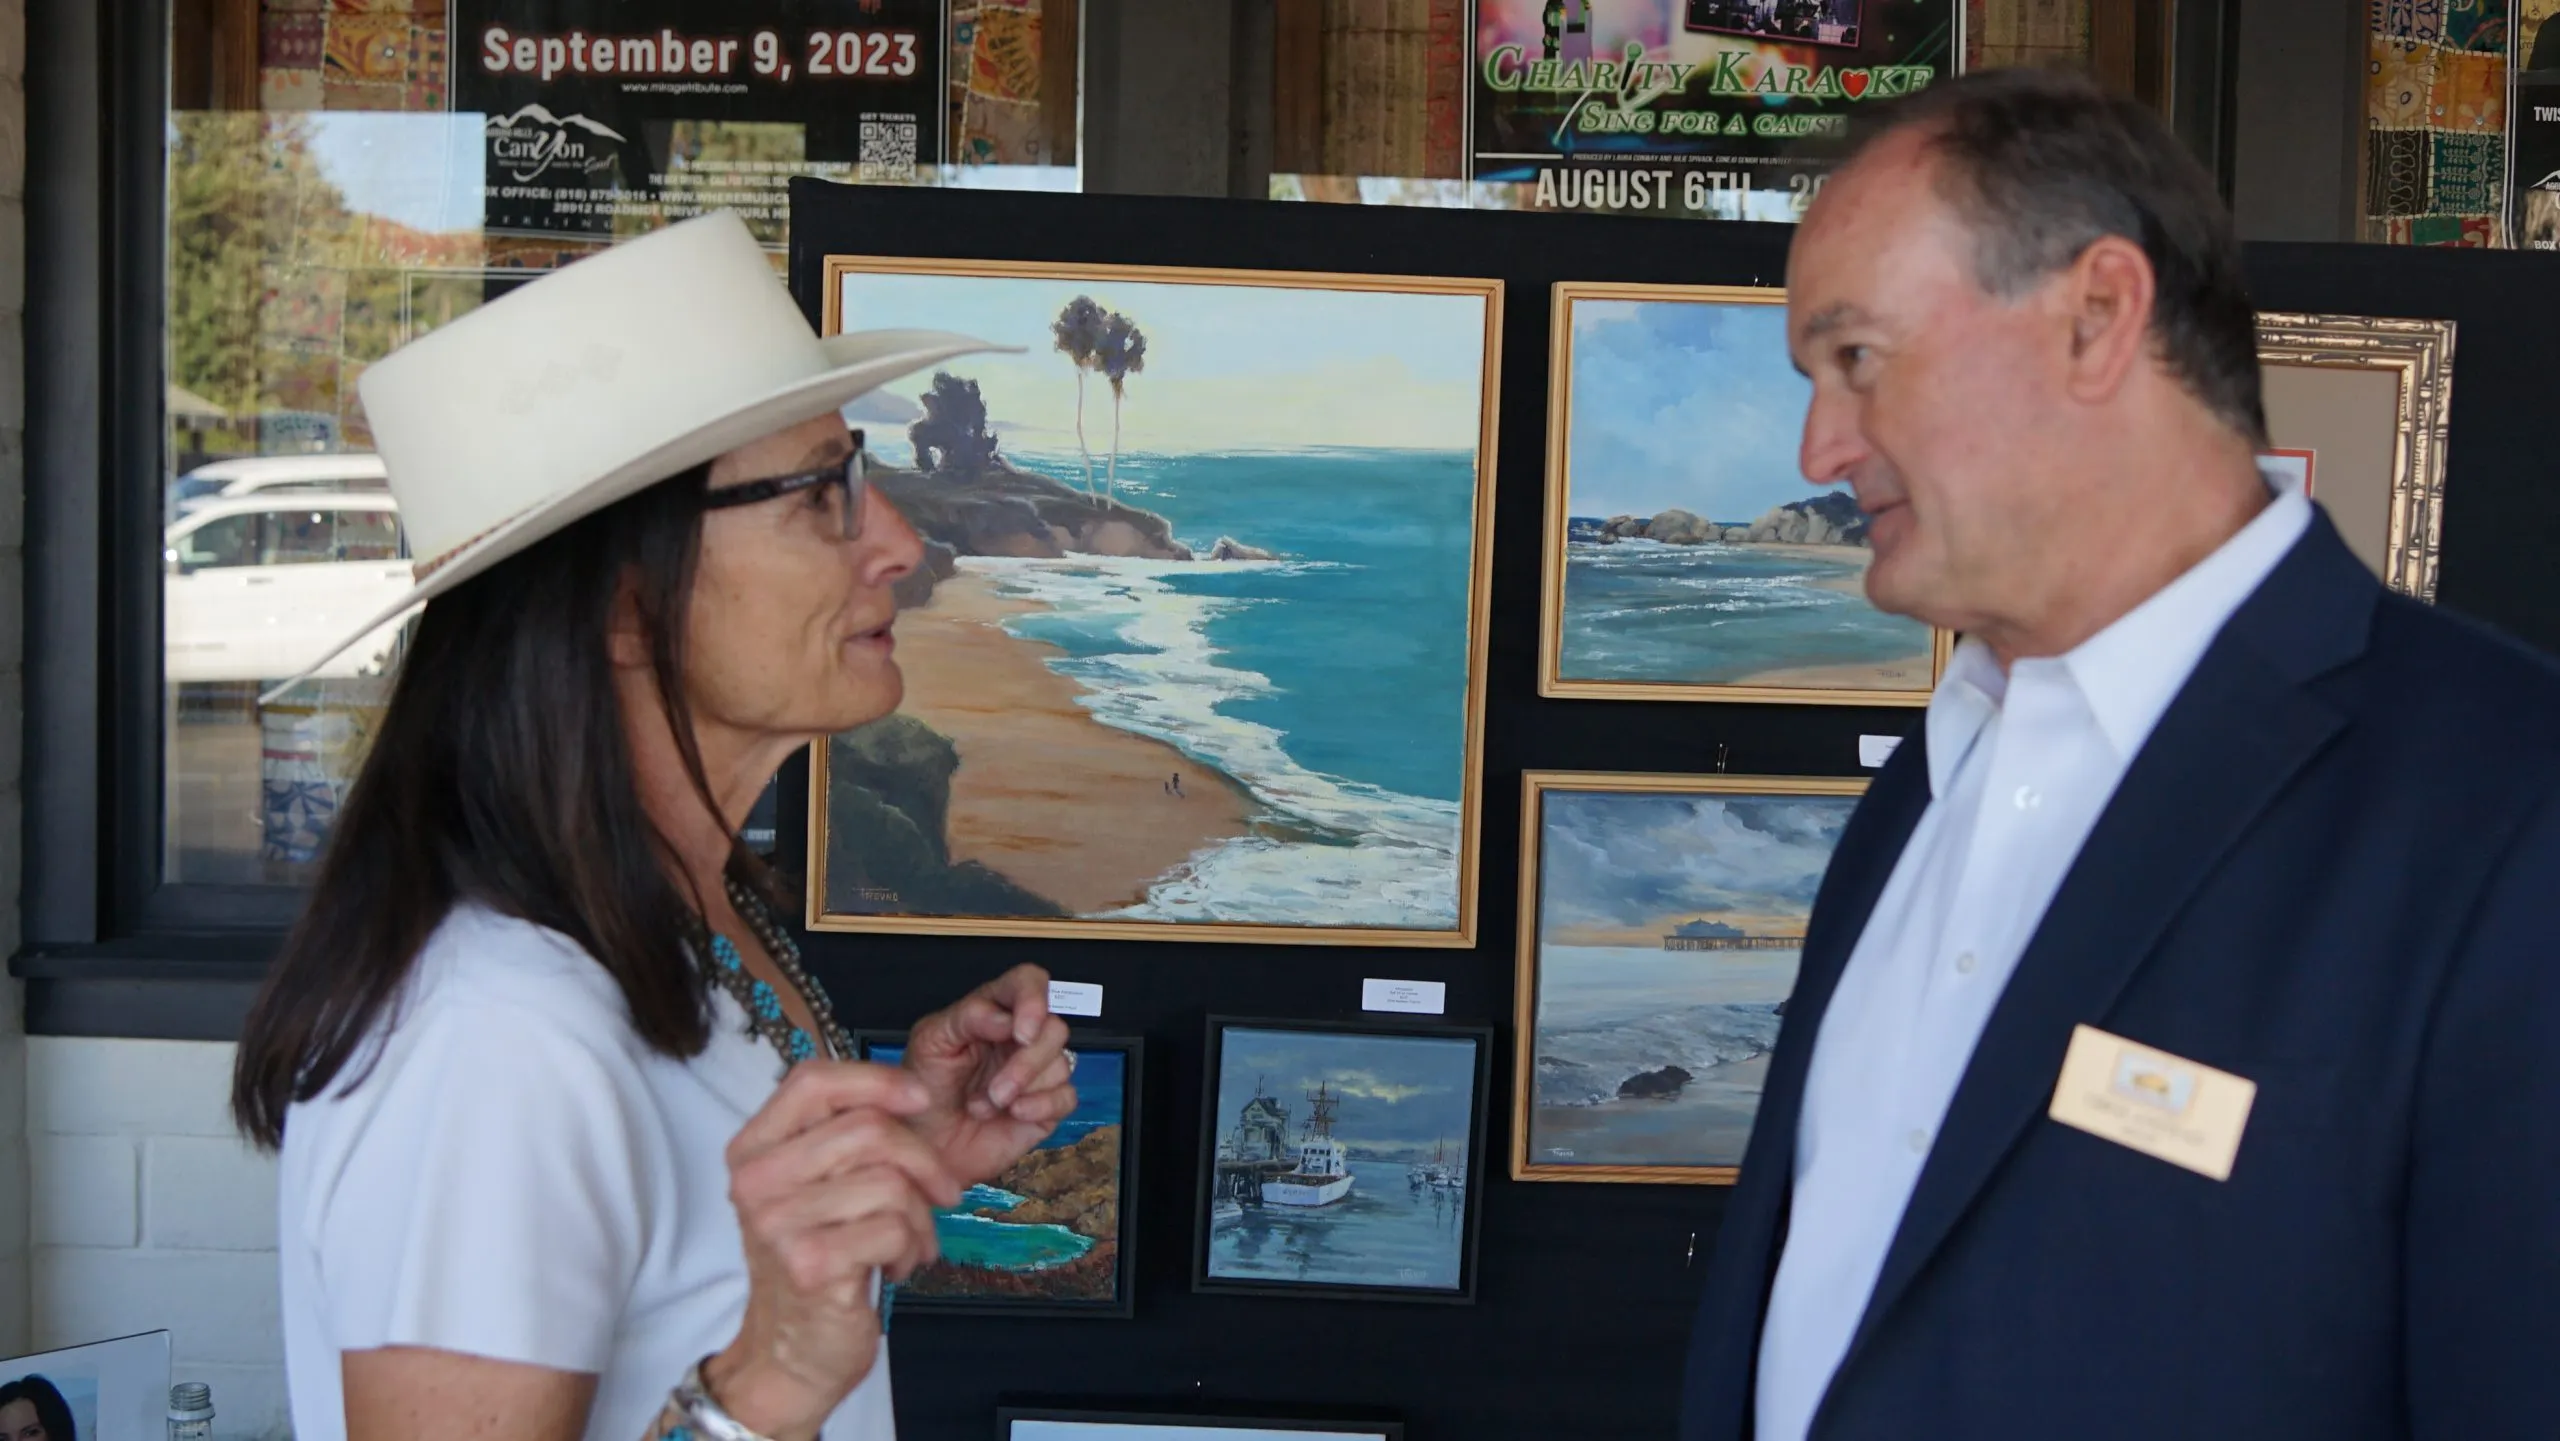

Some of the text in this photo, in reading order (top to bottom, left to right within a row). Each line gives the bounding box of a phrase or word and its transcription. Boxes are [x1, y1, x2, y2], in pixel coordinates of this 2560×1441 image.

[484, 28, 917, 82] September 9, 2023
[1579, 103, 1848, 138] SING FOR A CAUSE
[501, 187, 551, 199] OFFICE:
[1534, 168, 1674, 210] AUGUST
[1684, 171, 1751, 212] 6TH
